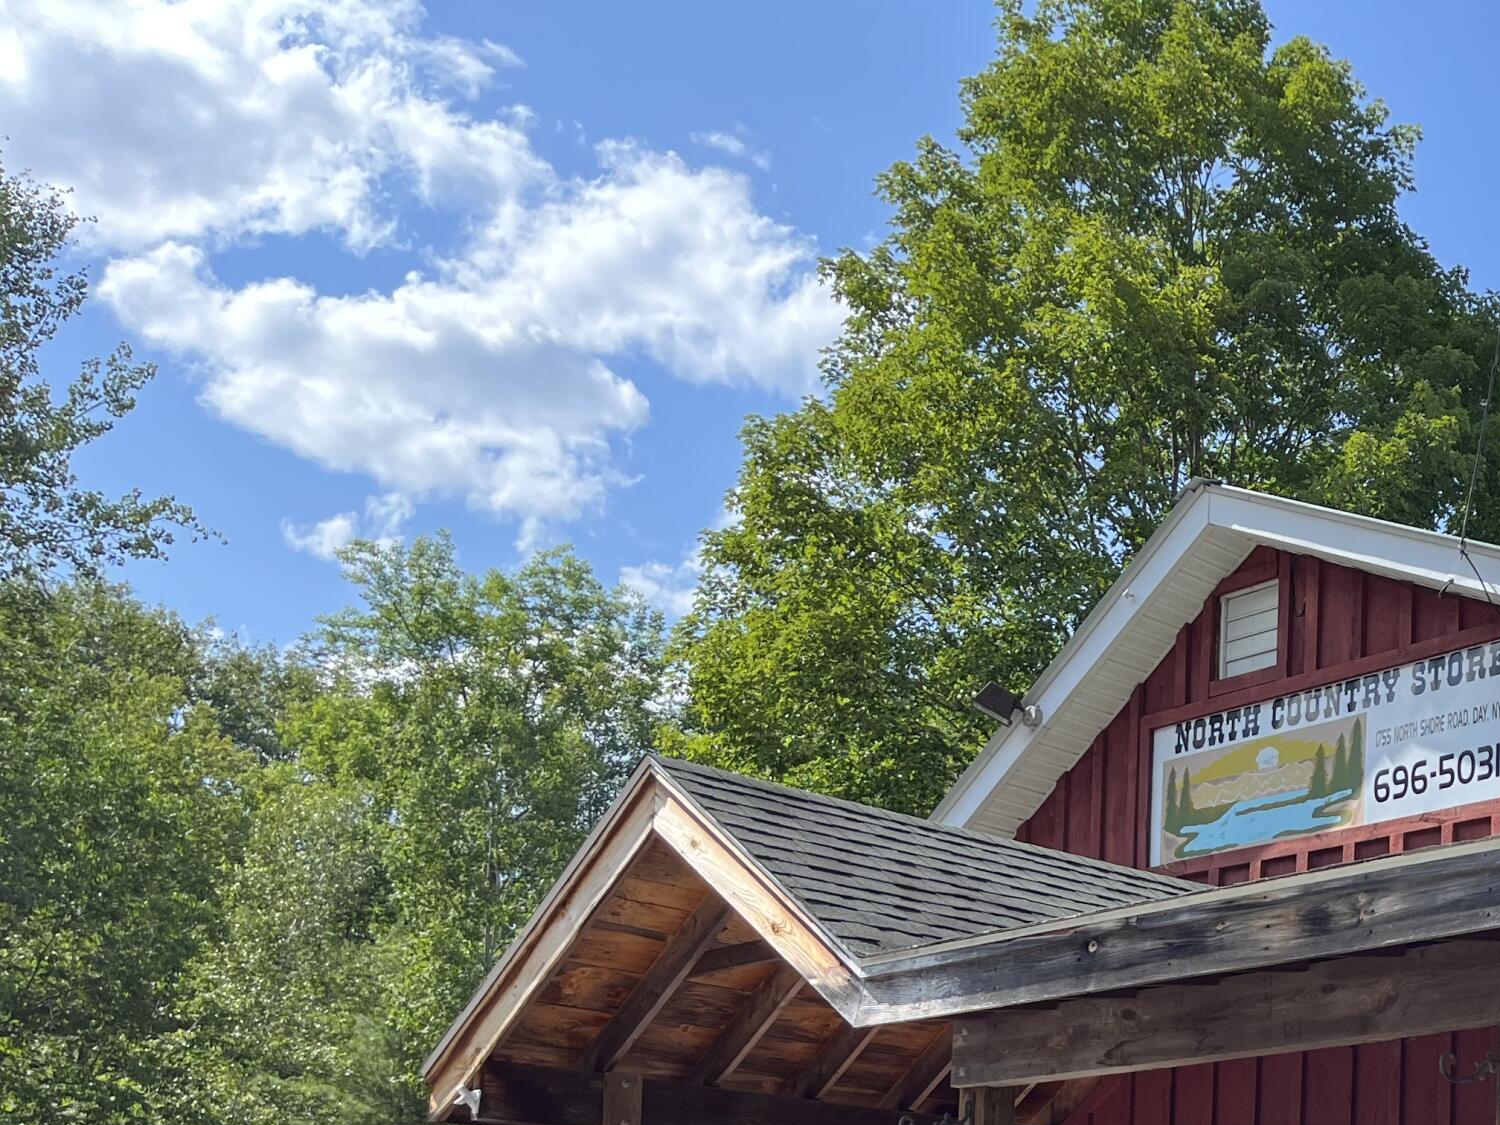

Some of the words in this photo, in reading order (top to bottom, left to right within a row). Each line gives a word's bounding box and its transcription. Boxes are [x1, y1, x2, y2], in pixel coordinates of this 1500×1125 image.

[1175, 704, 1261, 754] NORTH
[1271, 668, 1401, 730] COUNTRY
[1393, 721, 1418, 743] NORTH
[1420, 714, 1445, 737] SHORE
[1447, 709, 1469, 730] ROAD
[1374, 743, 1500, 803] 696-5031
